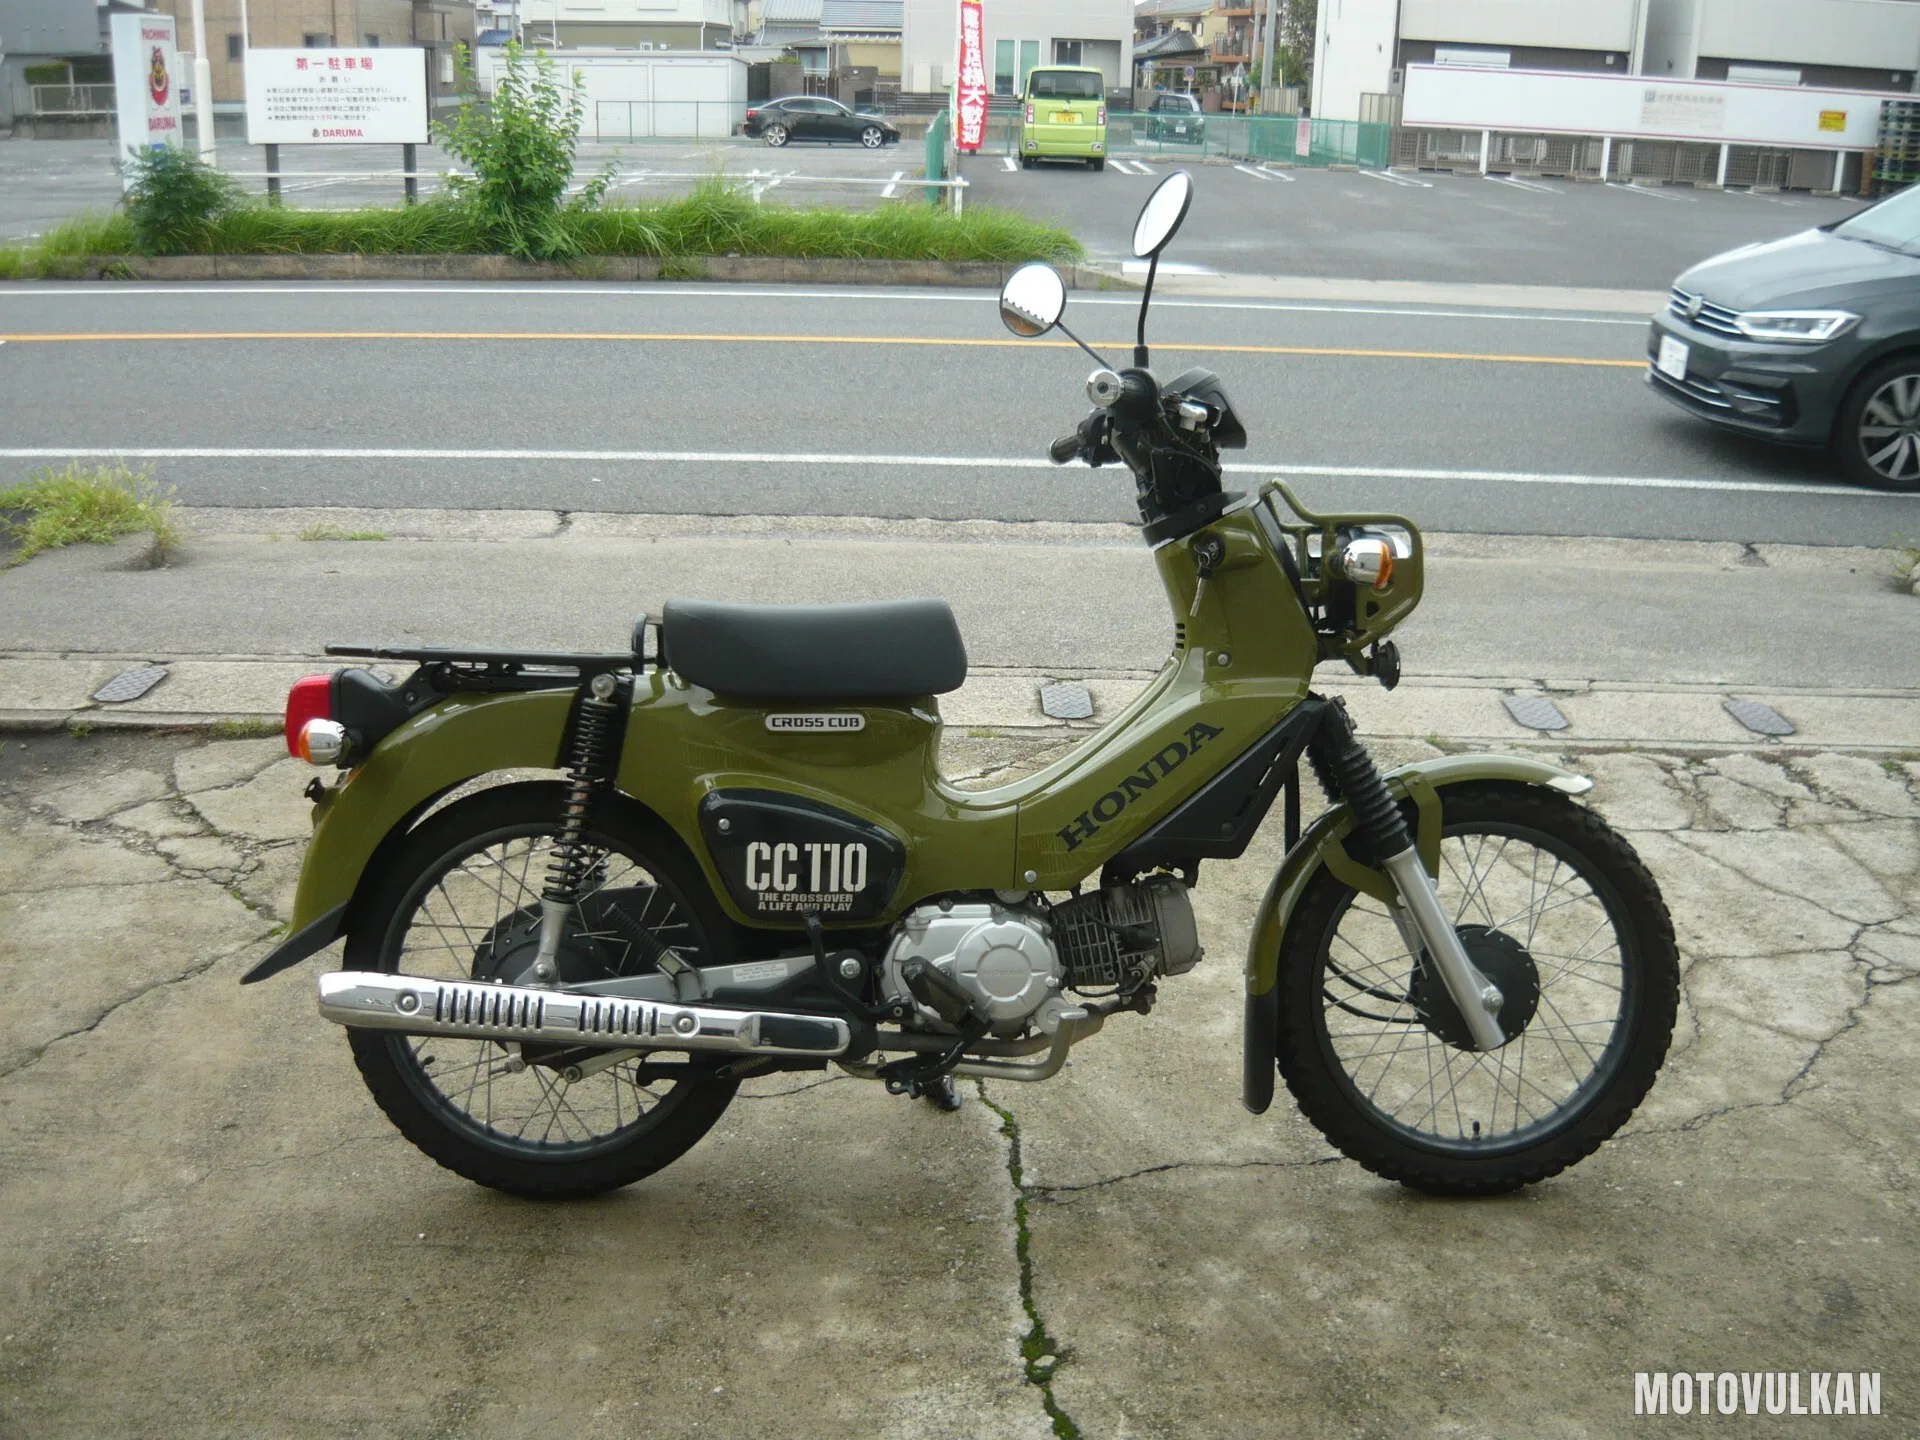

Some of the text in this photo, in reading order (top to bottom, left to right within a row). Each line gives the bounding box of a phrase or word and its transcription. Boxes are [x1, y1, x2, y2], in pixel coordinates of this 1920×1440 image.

[296, 57, 374, 70] 第一駐車場
[149, 116, 176, 131] DARUMA
[322, 128, 364, 137] DARUMA
[772, 717, 860, 728] CROSS CUB
[1056, 722, 1225, 852] HONDA
[758, 892, 854, 903] THE CROSSOVER
[758, 901, 767, 911] A
[769, 902, 793, 911] LIFE
[823, 902, 853, 911] PLAY
